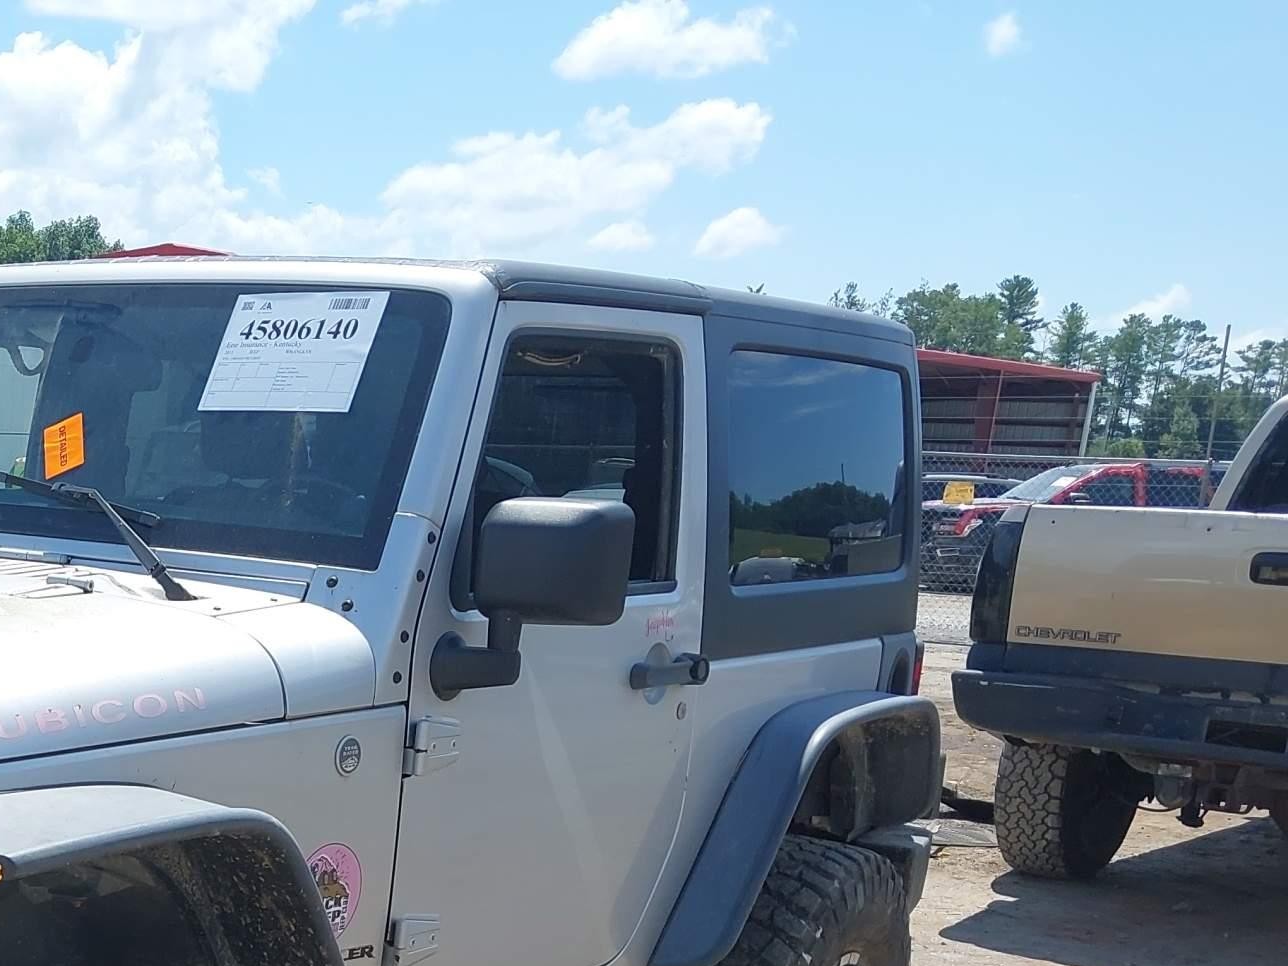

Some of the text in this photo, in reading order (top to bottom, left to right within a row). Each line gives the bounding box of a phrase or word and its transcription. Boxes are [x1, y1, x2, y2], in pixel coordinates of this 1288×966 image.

[240, 318, 359, 340] 45806140
[58, 425, 68, 467] DETAILED
[1015, 625, 1122, 644] CHEVROLET
